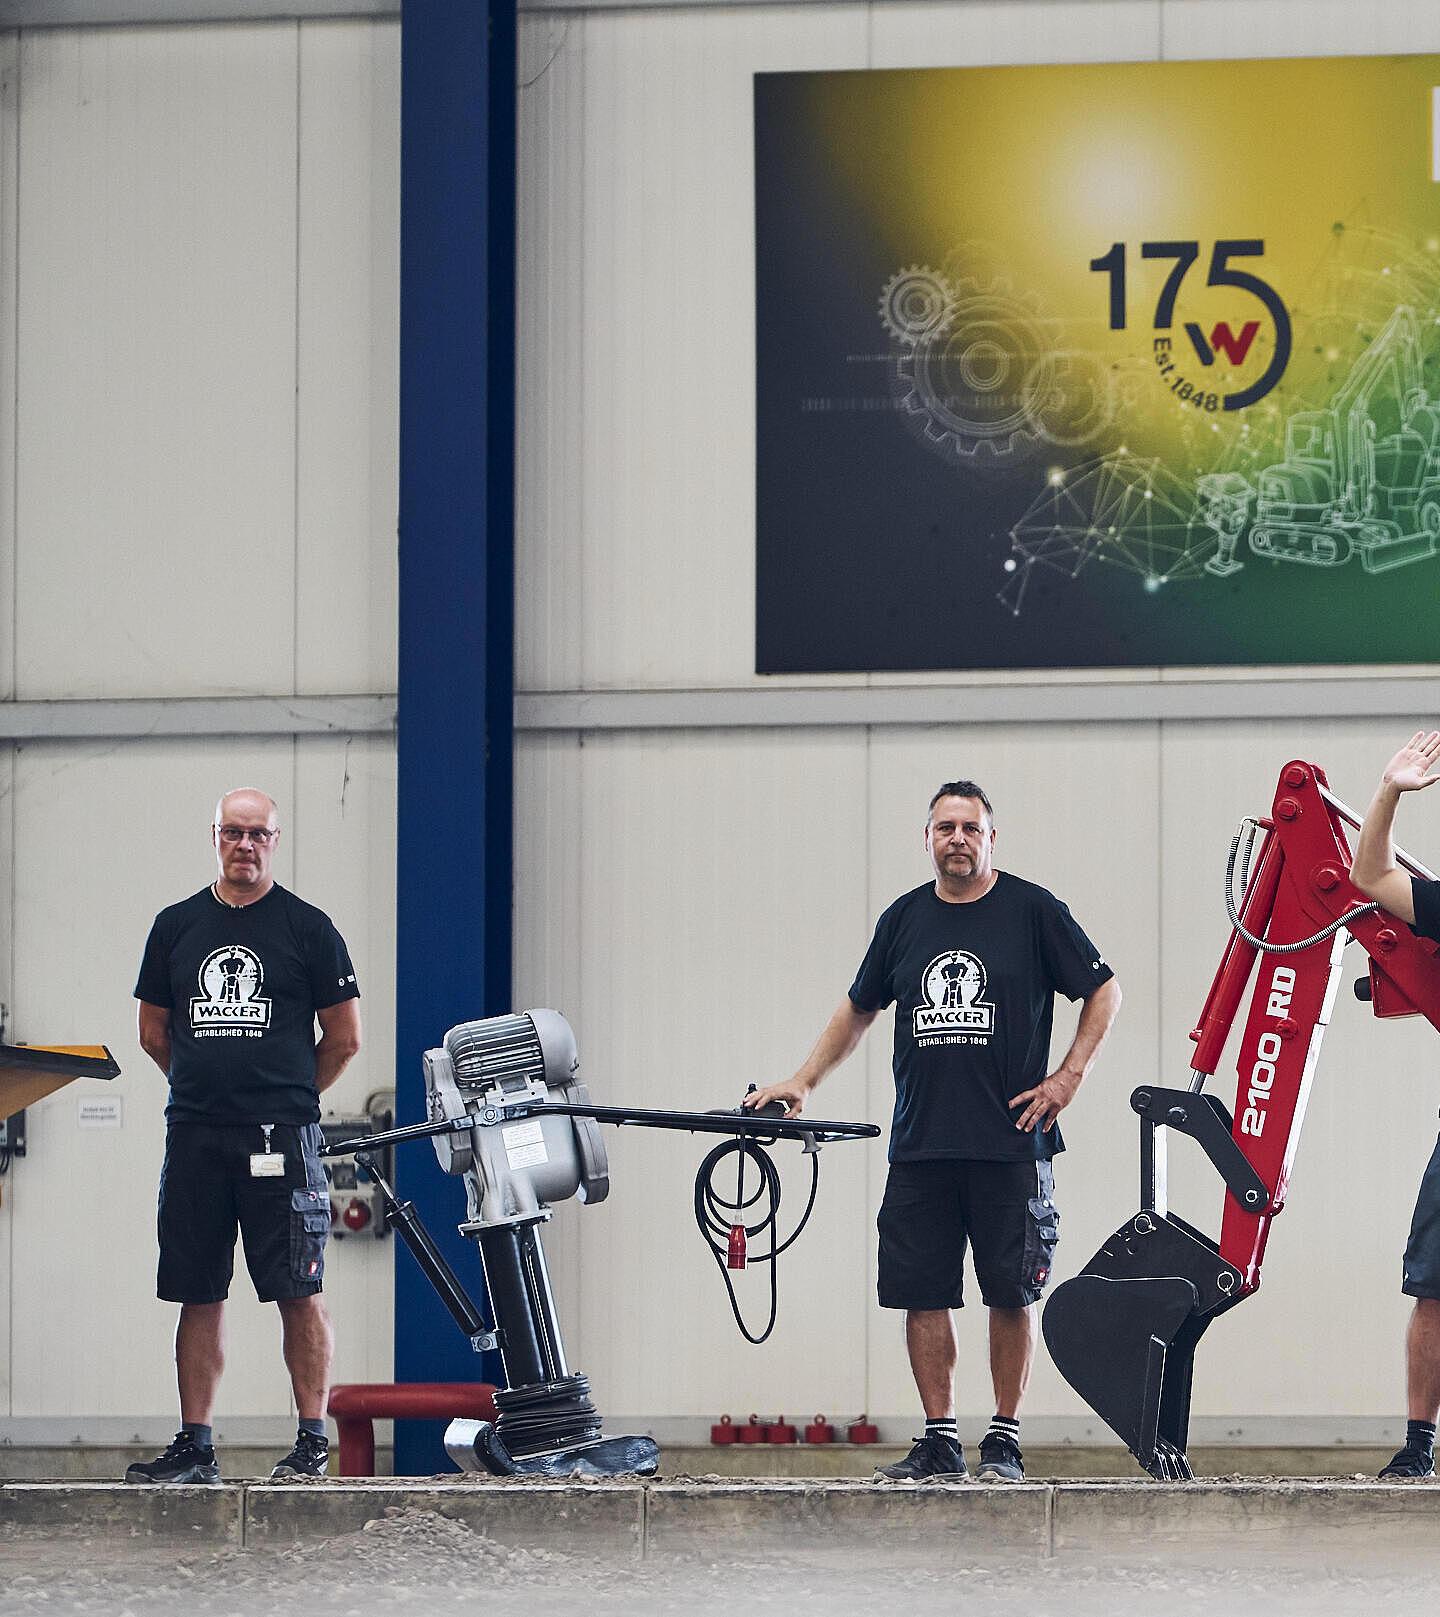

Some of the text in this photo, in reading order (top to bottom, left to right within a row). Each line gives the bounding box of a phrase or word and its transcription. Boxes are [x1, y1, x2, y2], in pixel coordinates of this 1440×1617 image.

[1089, 238, 1292, 411] 175
[1184, 321, 1261, 366] W
[198, 1006, 262, 1018] WACKER
[920, 1011, 985, 1025] WACKER
[194, 1029, 243, 1038] ESTABLISHED
[918, 1036, 968, 1047] ESTABLISHED
[1240, 966, 1297, 1137] 2100 RD
